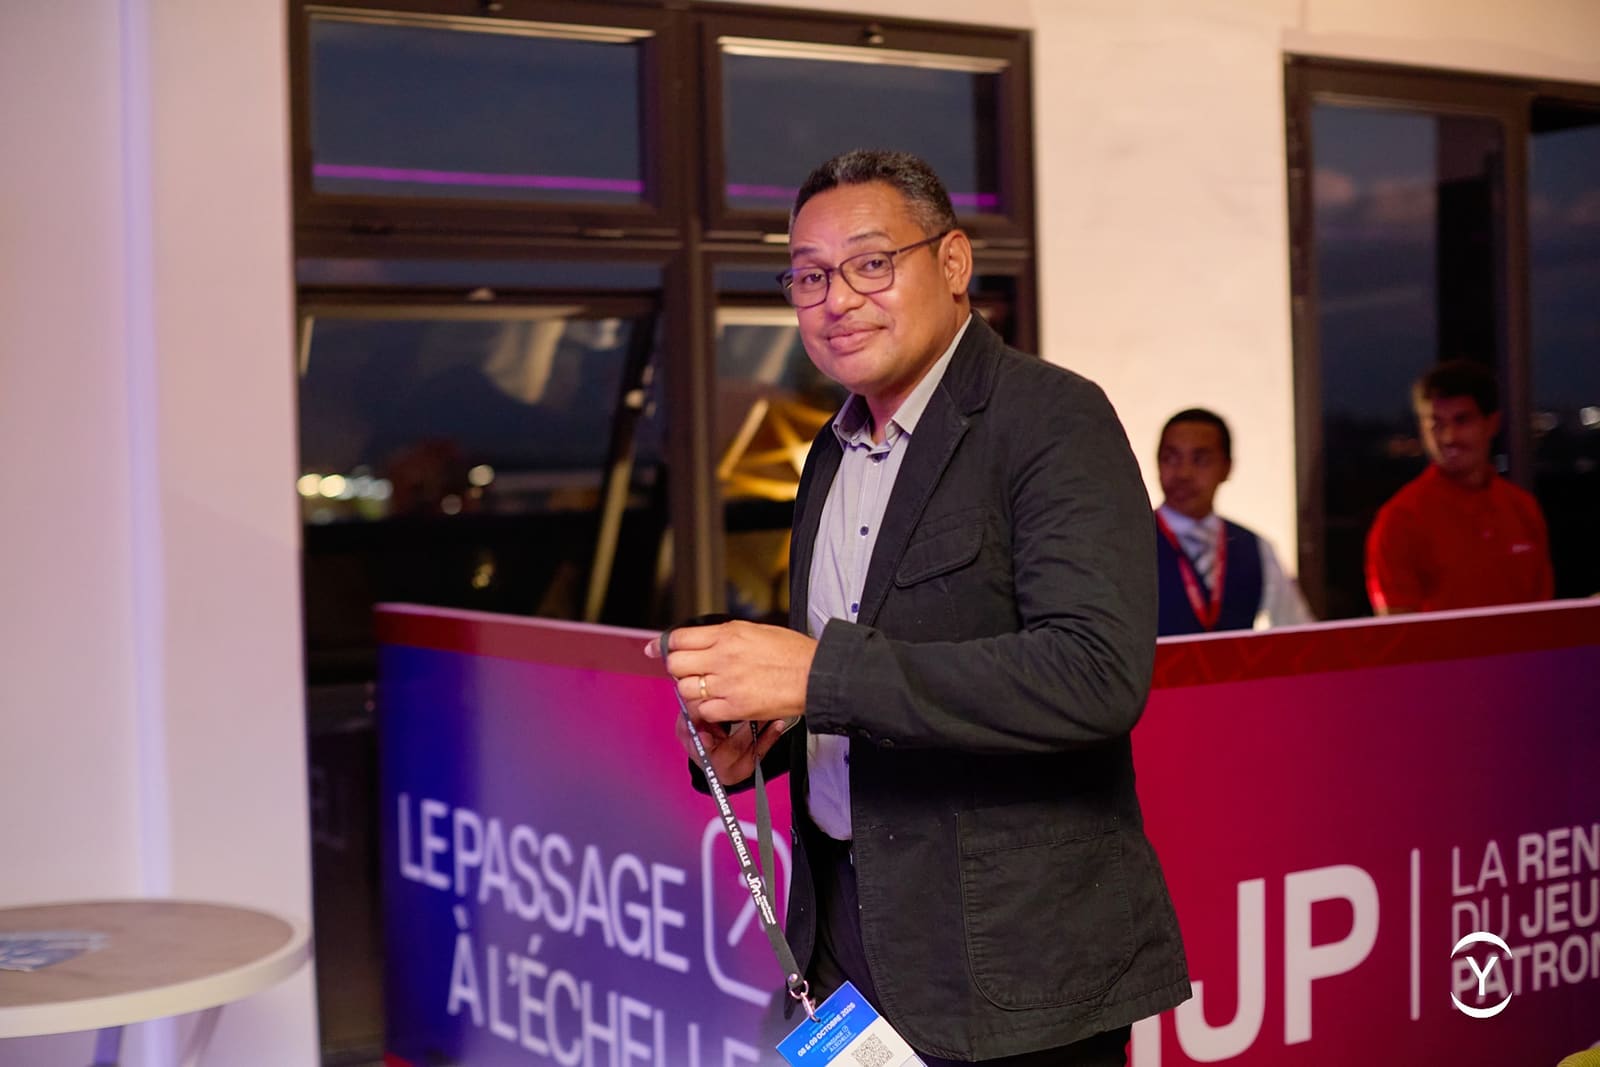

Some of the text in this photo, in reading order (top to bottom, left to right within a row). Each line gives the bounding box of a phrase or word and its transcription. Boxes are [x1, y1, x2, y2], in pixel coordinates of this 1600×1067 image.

[705, 766, 715, 778] LE
[710, 777, 732, 816] PASSAGE
[398, 792, 690, 974] LE PASSAGE
[1451, 823, 1600, 896] LA REN
[1451, 877, 1600, 952] DU JEU
[447, 904, 483, 1027] À
[816, 1014, 842, 1040] OCTOBRE
